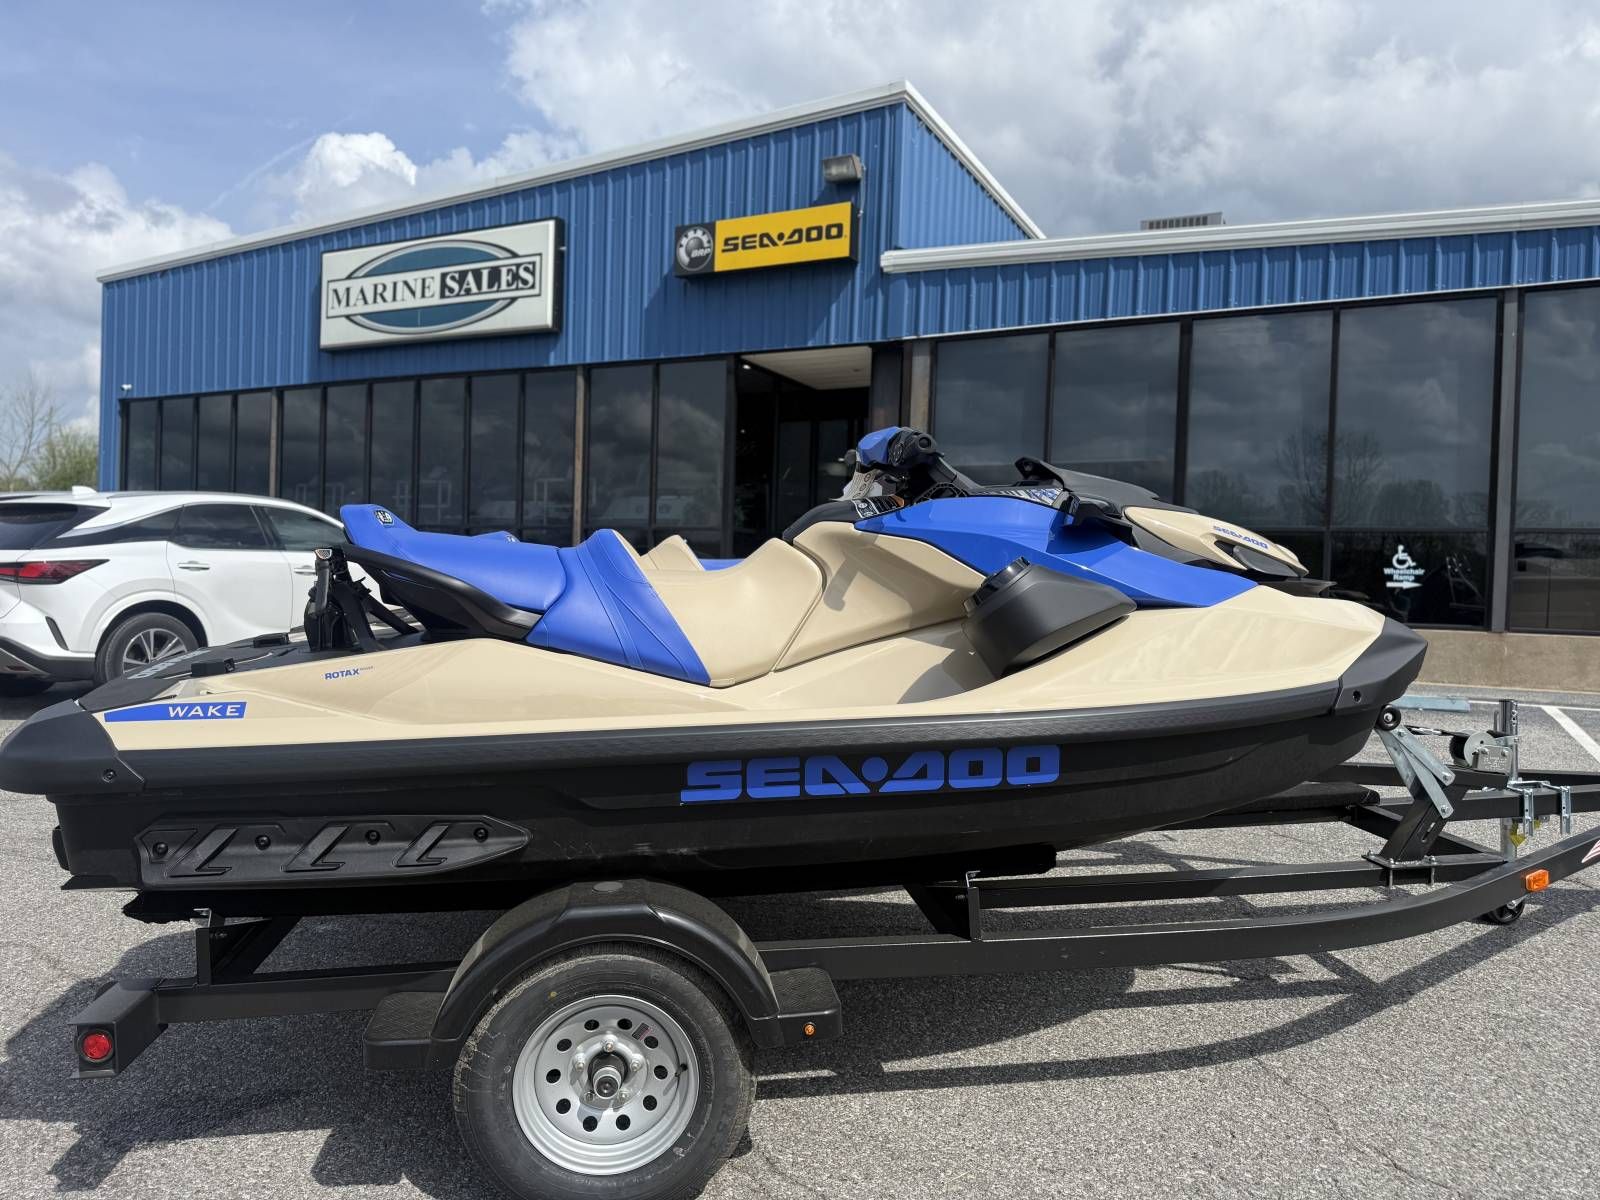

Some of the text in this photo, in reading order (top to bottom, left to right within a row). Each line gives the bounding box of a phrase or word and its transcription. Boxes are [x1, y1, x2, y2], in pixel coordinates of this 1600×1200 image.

[330, 263, 536, 310] MARINE SALES
[1383, 567, 1425, 575] Wheelchair
[324, 668, 360, 680] ROTAX
[168, 704, 241, 718] WAKE
